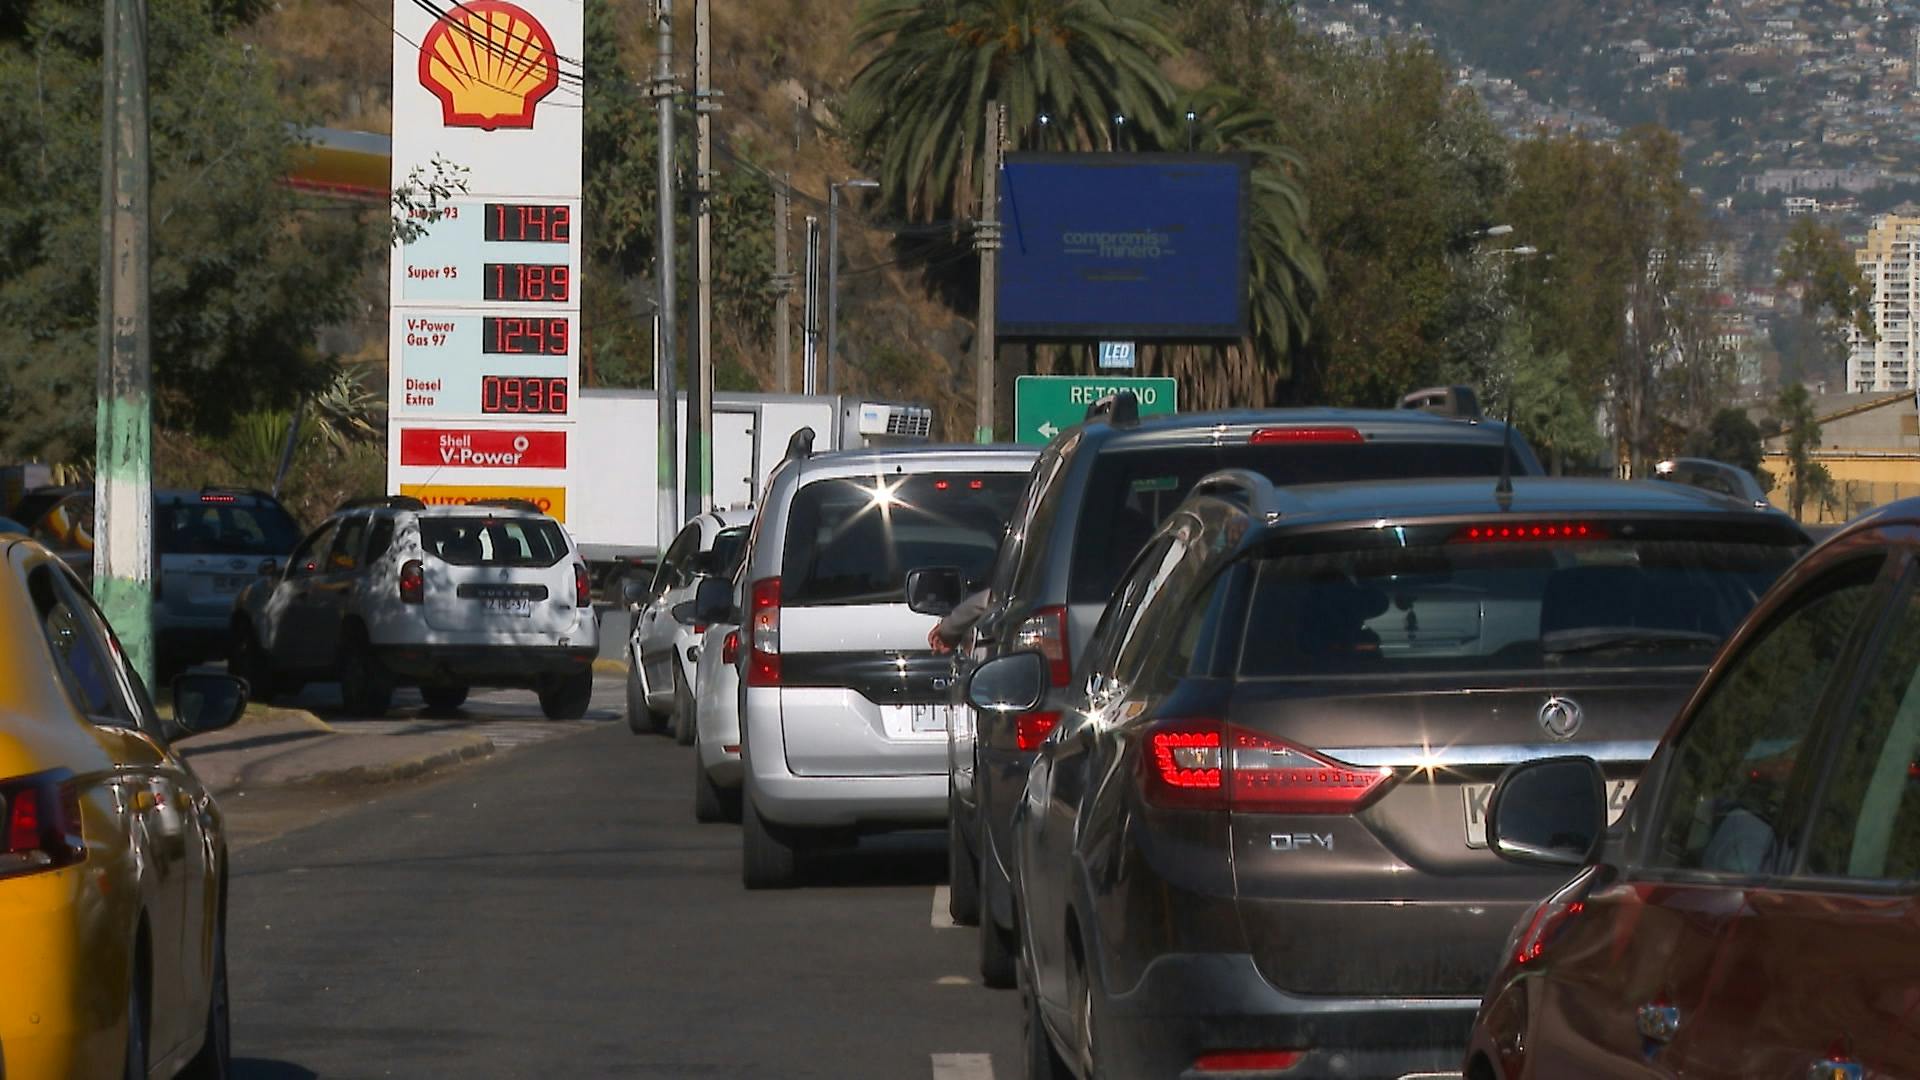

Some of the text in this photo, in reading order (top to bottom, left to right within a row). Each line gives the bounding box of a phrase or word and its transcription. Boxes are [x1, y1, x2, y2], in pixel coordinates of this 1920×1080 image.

[407, 207, 458, 221] Sup 93
[496, 206, 569, 241] 1142
[408, 265, 457, 280] Super 95
[496, 264, 569, 300] 1189
[407, 319, 455, 332] V-Power
[407, 333, 447, 346] Gas 97
[495, 317, 568, 354] 1249
[1104, 343, 1130, 359] LED
[406, 378, 441, 391] Diesel
[405, 393, 435, 406] Extra
[483, 376, 568, 413] 0936
[1070, 386, 1157, 405] RETNO
[439, 435, 471, 447] Shell
[439, 447, 523, 465] V-Power
